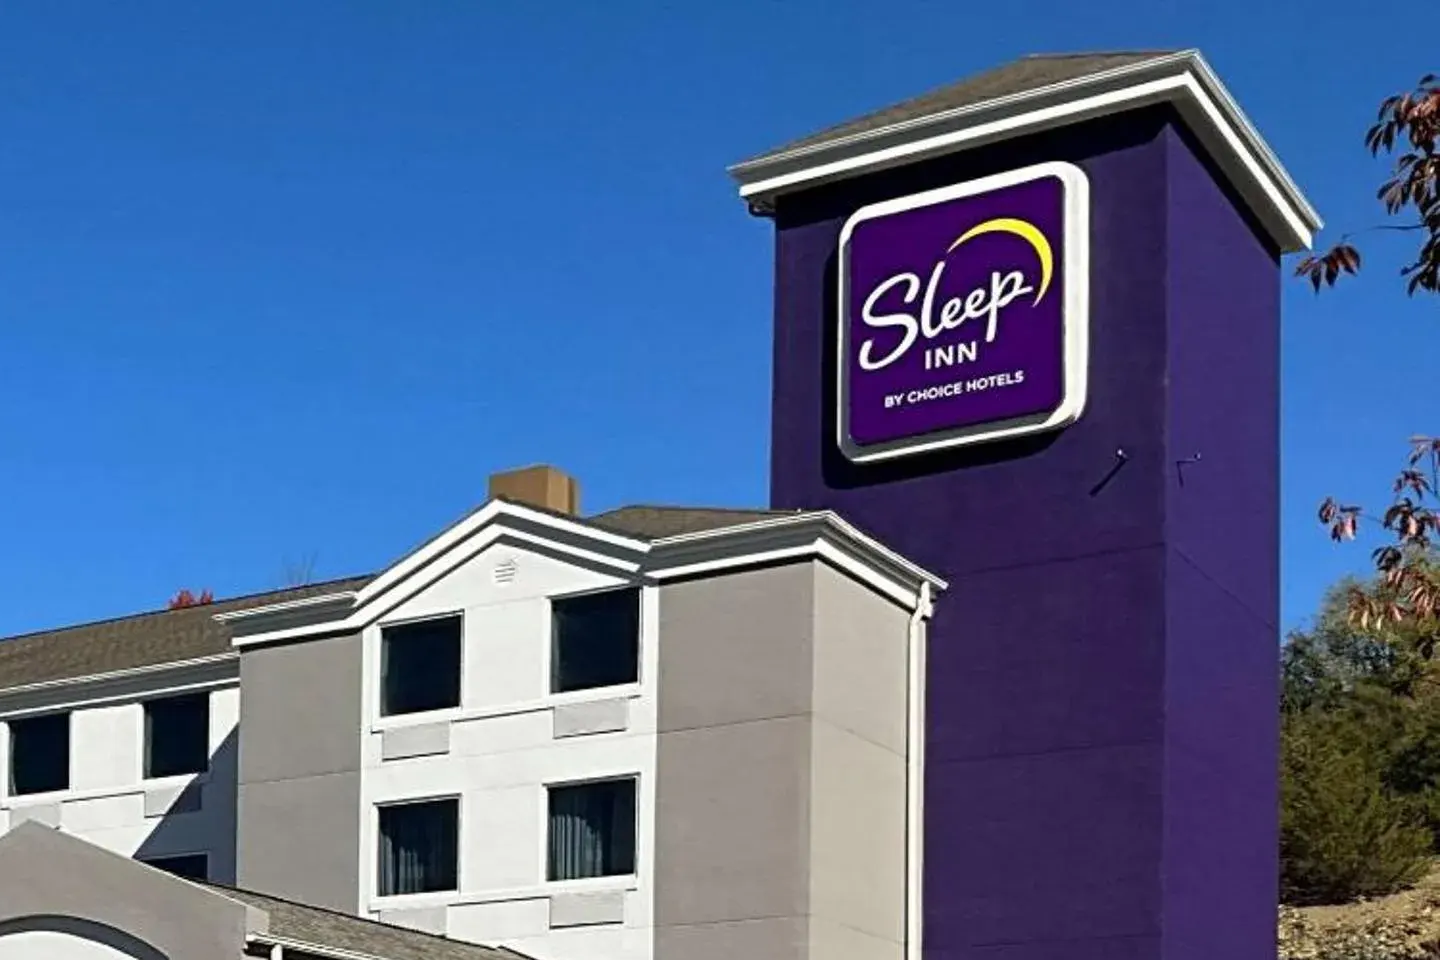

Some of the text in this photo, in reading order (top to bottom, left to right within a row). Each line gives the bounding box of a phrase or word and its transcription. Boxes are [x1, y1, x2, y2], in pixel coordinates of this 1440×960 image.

[858, 261, 1033, 371] Sleep
[924, 341, 977, 371] INN
[884, 370, 1025, 409] BY CHOICE HOTELS
